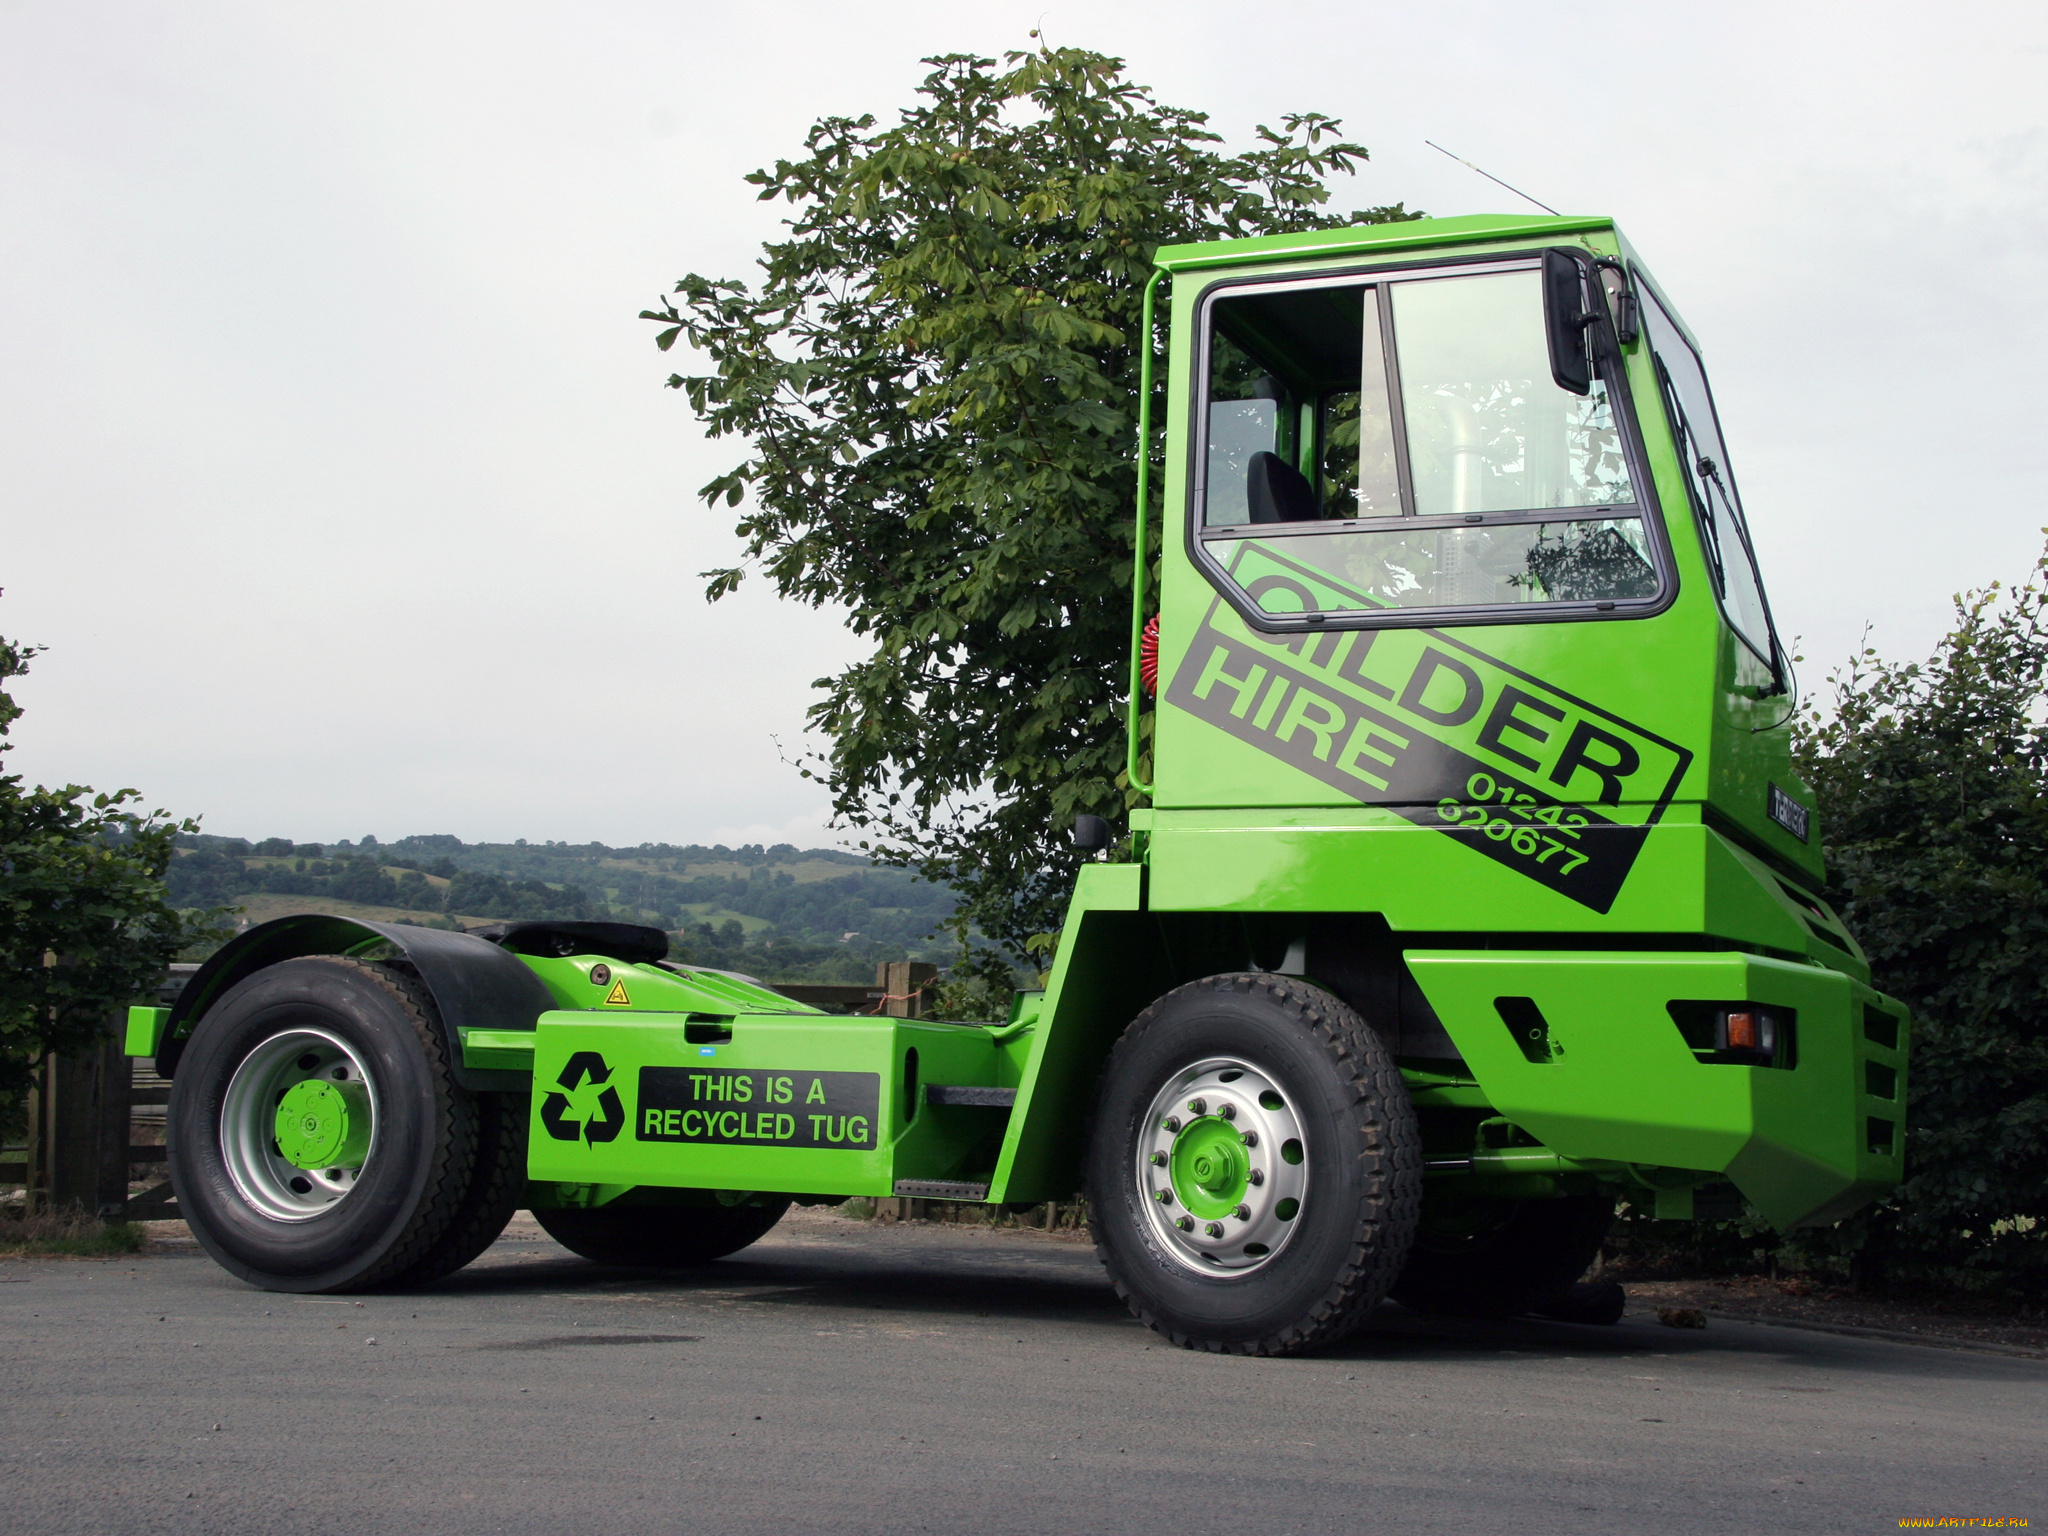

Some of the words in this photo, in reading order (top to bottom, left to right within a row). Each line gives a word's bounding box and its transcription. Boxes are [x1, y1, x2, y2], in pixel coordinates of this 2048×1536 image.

[1192, 648, 1409, 791] HIRE
[1437, 797, 1590, 876] 620677
[1466, 772, 1589, 841] 01242
[689, 1075, 752, 1102] THIS
[766, 1077, 793, 1104] IS
[805, 1078, 826, 1104] A
[644, 1109, 796, 1140] RECYCLED
[808, 1116, 868, 1143] TUG
